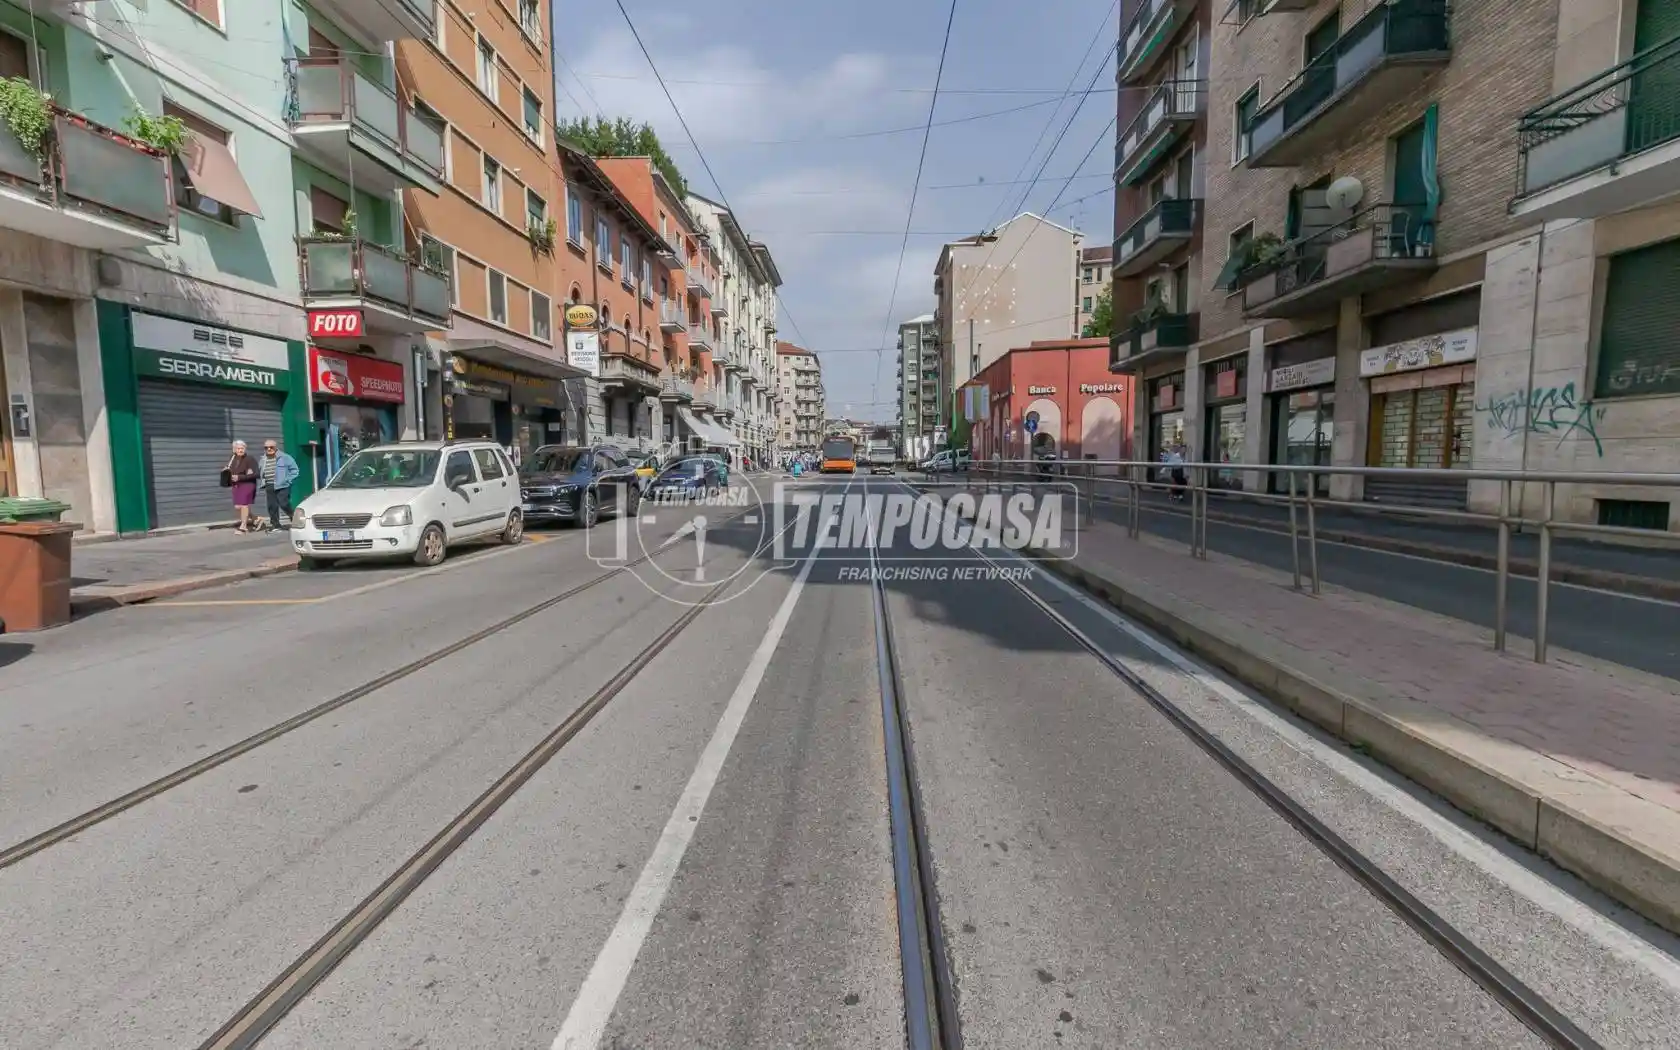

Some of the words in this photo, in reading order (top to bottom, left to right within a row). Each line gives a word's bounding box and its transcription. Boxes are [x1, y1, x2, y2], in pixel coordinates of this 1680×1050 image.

[314, 314, 358, 332] FOTO
[158, 357, 275, 386] SERRAMENTI
[1028, 385, 1057, 395] Banca
[1080, 382, 1124, 394] Popolare
